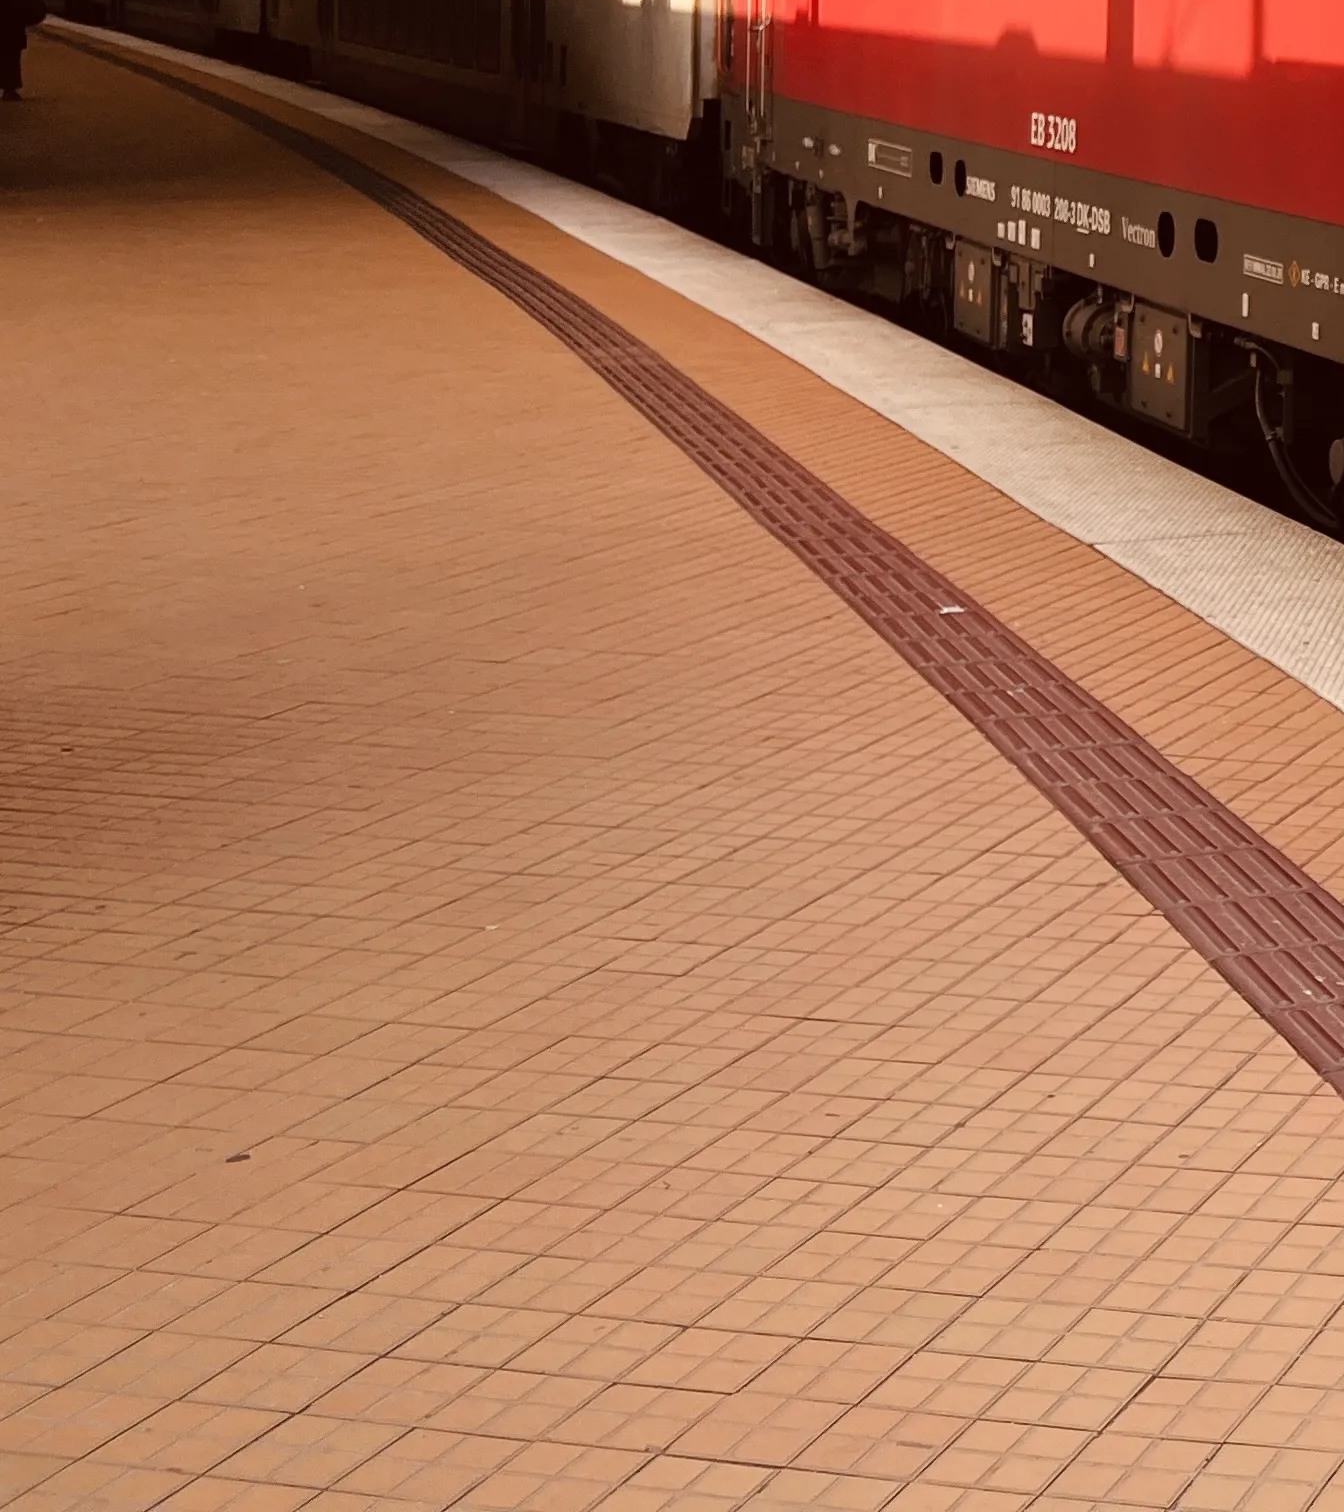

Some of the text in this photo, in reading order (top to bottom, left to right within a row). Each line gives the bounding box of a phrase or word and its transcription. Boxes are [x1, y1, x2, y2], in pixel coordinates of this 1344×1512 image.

[1030, 112, 1077, 154] EB 3208
[1010, 184, 1020, 209] 91
[1121, 216, 1156, 249] Vectron
